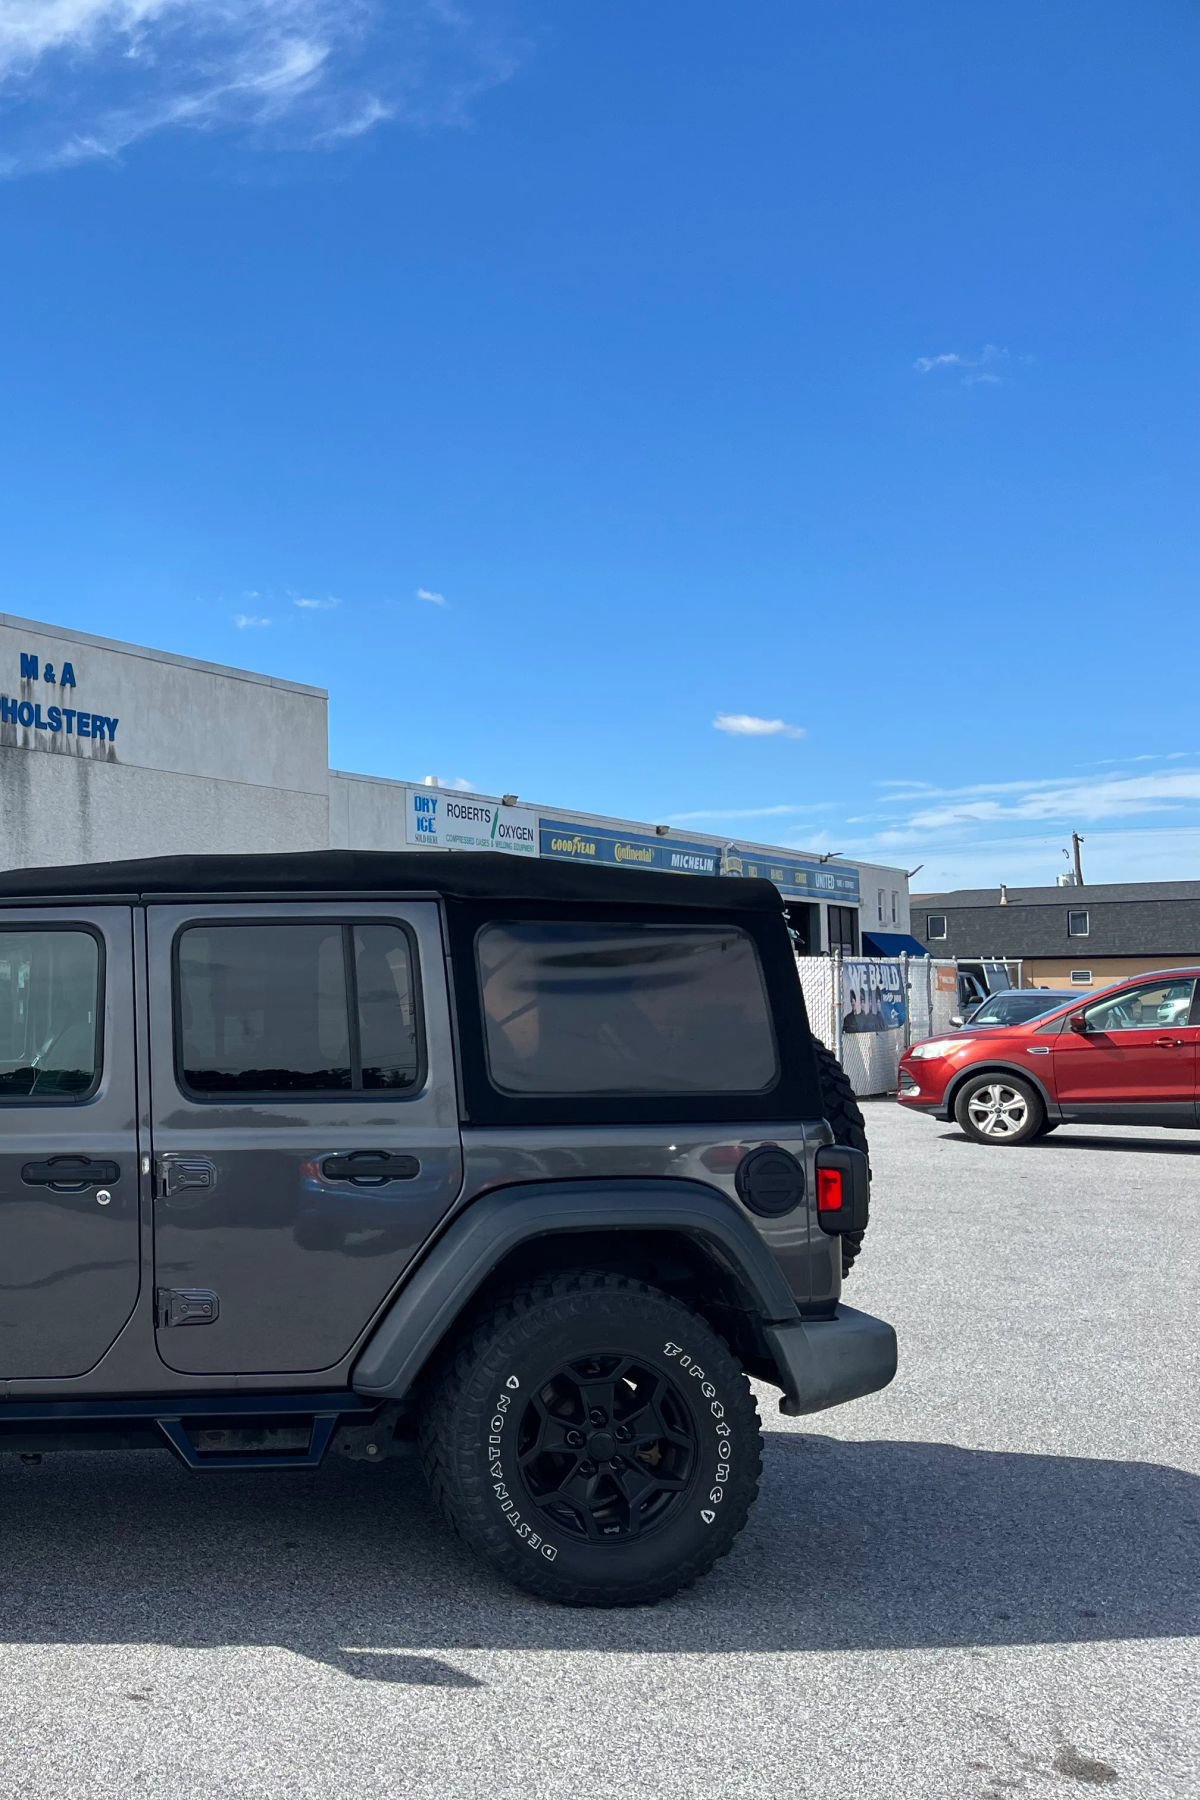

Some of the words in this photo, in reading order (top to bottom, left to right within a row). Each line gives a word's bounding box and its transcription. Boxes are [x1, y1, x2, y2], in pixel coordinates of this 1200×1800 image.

[20, 652, 39, 680] M
[43, 662, 56, 684] &
[60, 662, 76, 688] A
[414, 795, 438, 814] DRY
[447, 803, 491, 824] ROBERTS
[416, 816, 436, 834] ICE
[498, 823, 534, 841] OXYGEN
[551, 836, 596, 857] GOODYEAR
[614, 843, 652, 863] Continental
[671, 853, 714, 872] MICHELIN
[815, 873, 835, 890] UNITED
[848, 964, 868, 991] WE
[869, 964, 900, 991] BUILD
[489, 1394, 558, 1561] DESTINATION
